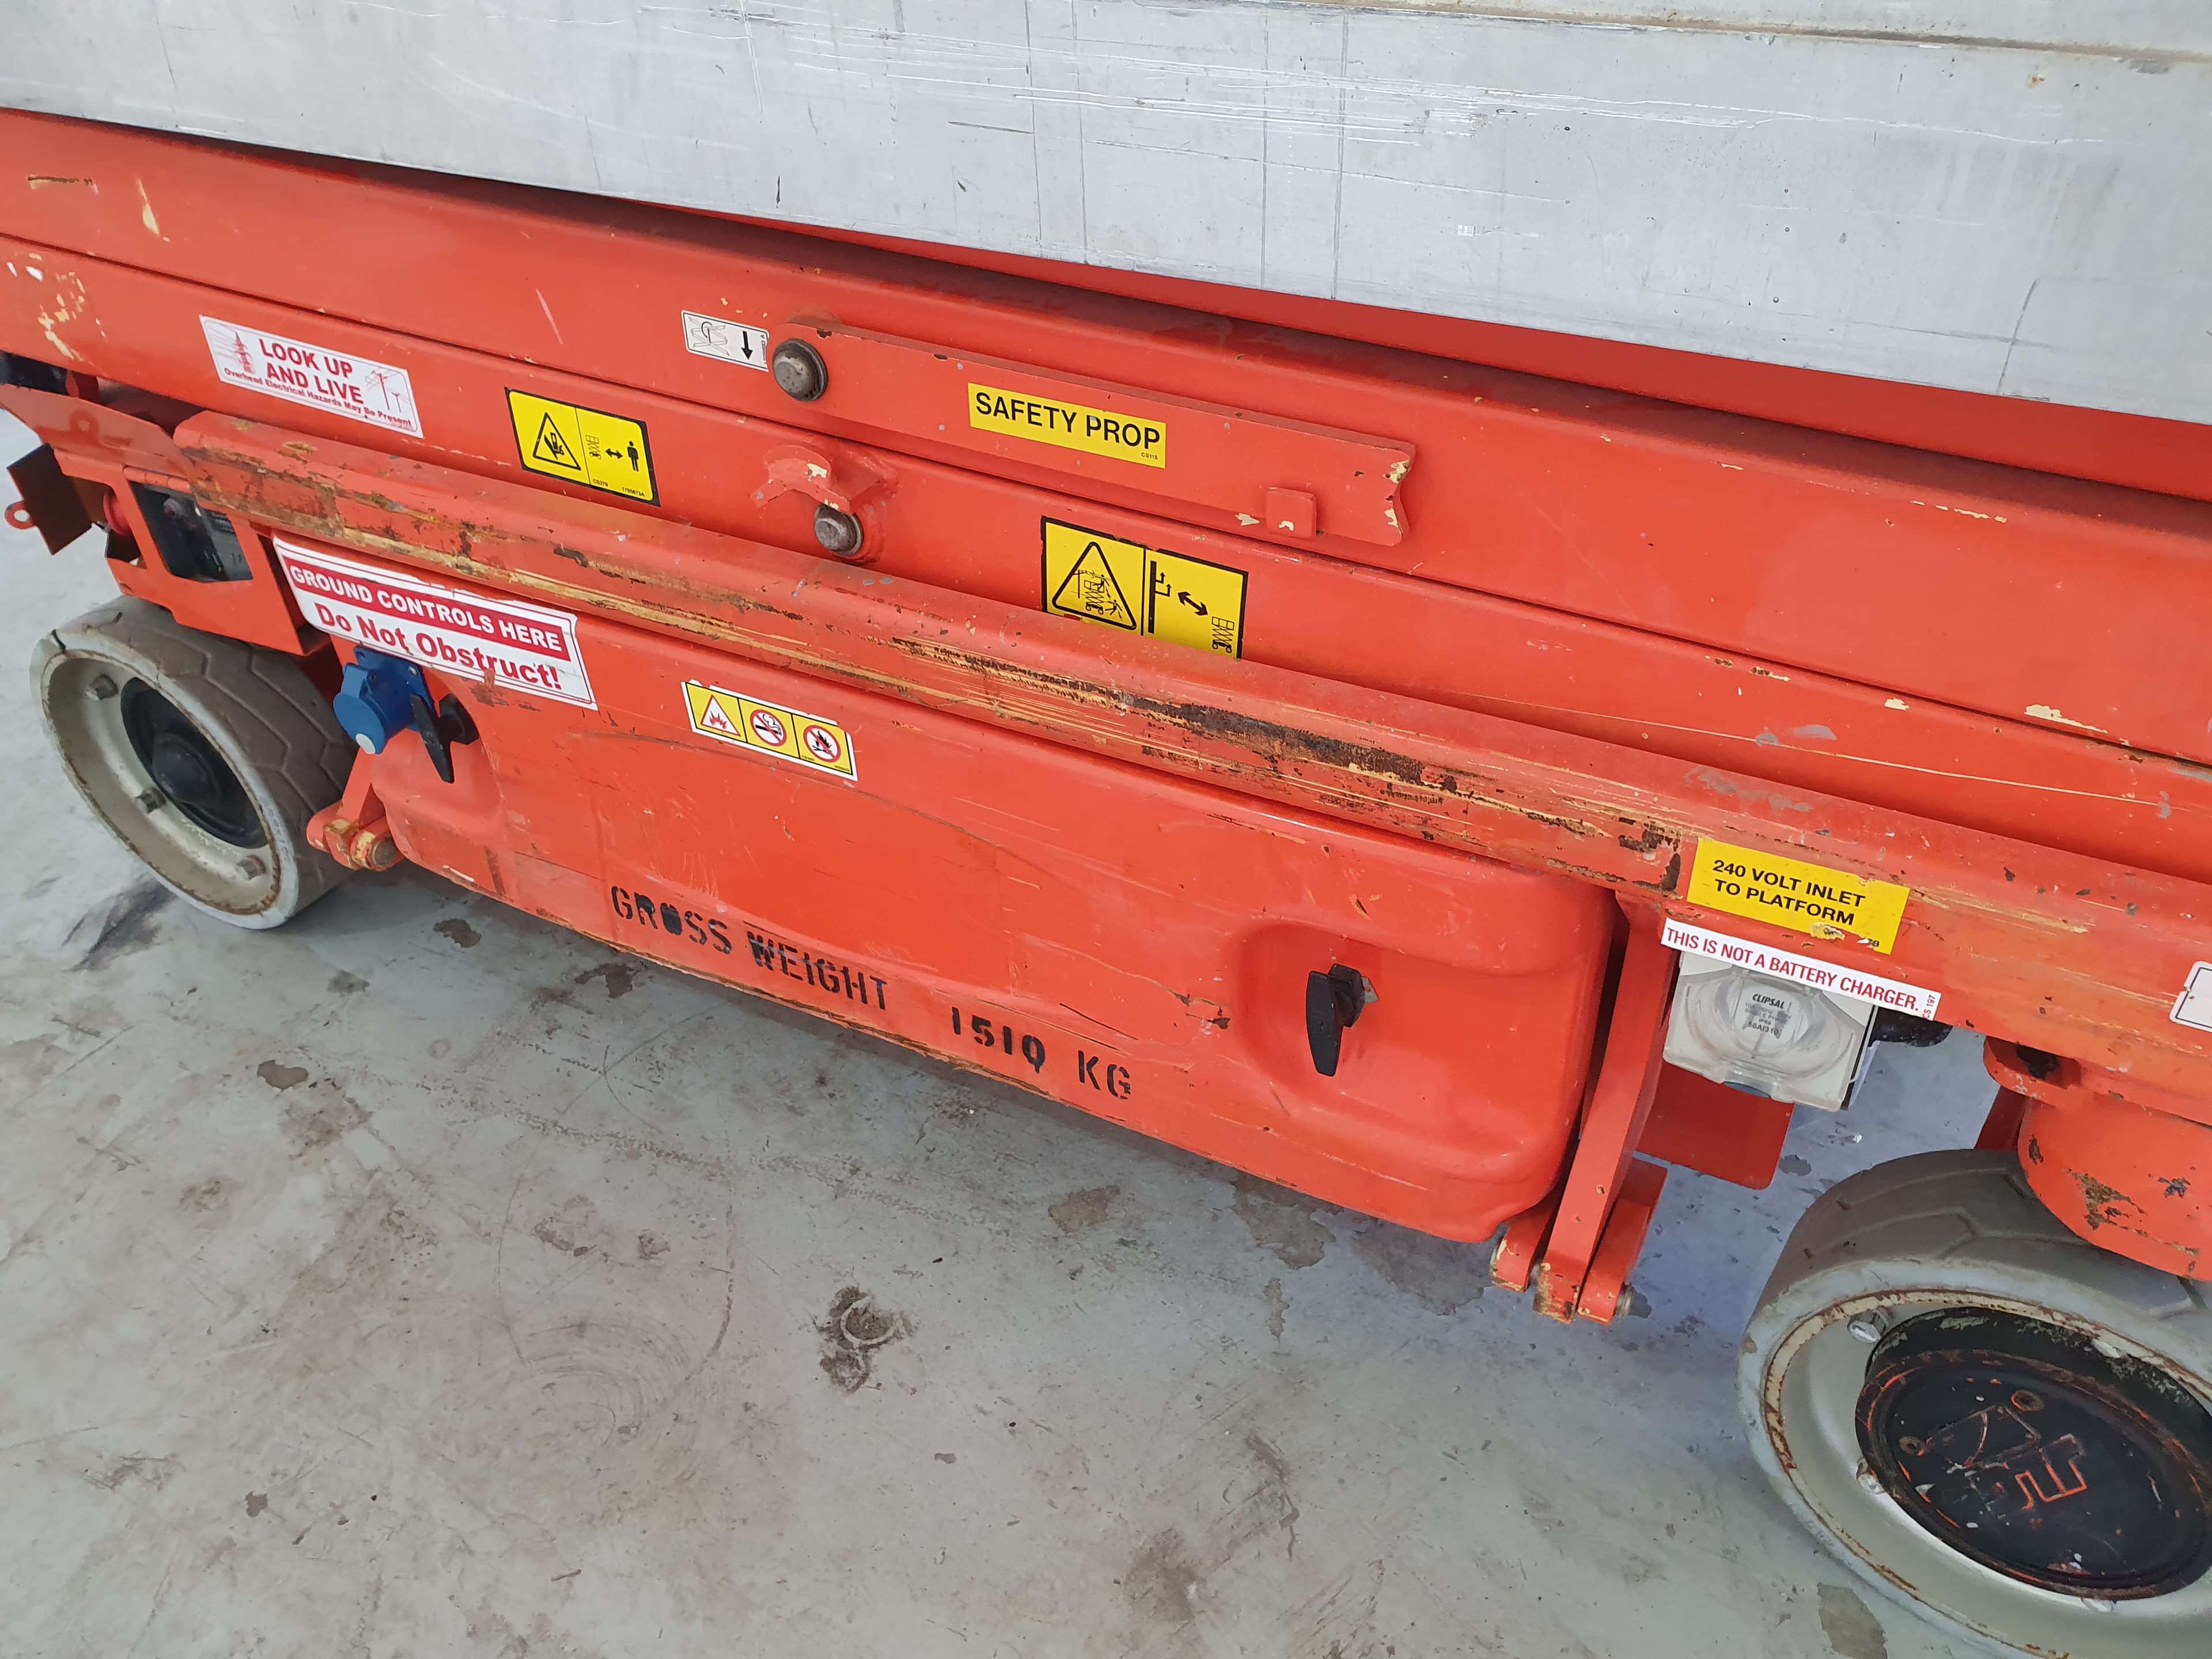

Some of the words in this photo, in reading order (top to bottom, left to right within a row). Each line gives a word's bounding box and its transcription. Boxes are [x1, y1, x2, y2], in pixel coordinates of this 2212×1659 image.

[259, 339, 320, 370] LOOK
[324, 356, 353, 379] UP
[267, 363, 308, 388] AND
[314, 375, 363, 404] LIVE
[224, 368, 263, 384] Overhead
[265, 379, 305, 396] Electrical
[307, 391, 342, 407] Hazards
[344, 402, 361, 414] May
[363, 407, 376, 416] Be
[378, 411, 411, 426] Present
[976, 392, 1077, 433] SAFETY
[1086, 415, 1160, 449] PROP
[289, 565, 372, 604] GROUND
[376, 590, 494, 634] CONTROLS
[498, 620, 563, 653] HERE
[315, 602, 351, 632] Do
[356, 615, 408, 652] Not
[416, 632, 562, 690] Obstruct!
[1712, 859, 1747, 878] 240
[1751, 868, 1802, 890] VOLT
[1805, 882, 1866, 907] INLET
[1714, 879, 1741, 896] TO
[1746, 886, 1855, 926] PLATFORM
[611, 885, 732, 954] GROSS
[747, 930, 887, 1010] WEIGHT
[1078, 1050, 1131, 1100] KG
[1666, 927, 1700, 950] THIS
[1702, 937, 1718, 955] IS
[1719, 942, 1753, 964] NOT
[1753, 953, 1766, 968] A
[1769, 957, 1838, 988] BATTERY
[1839, 976, 1919, 1012] CHARGER.
[1752, 994, 1785, 1009] CLIPSAL
